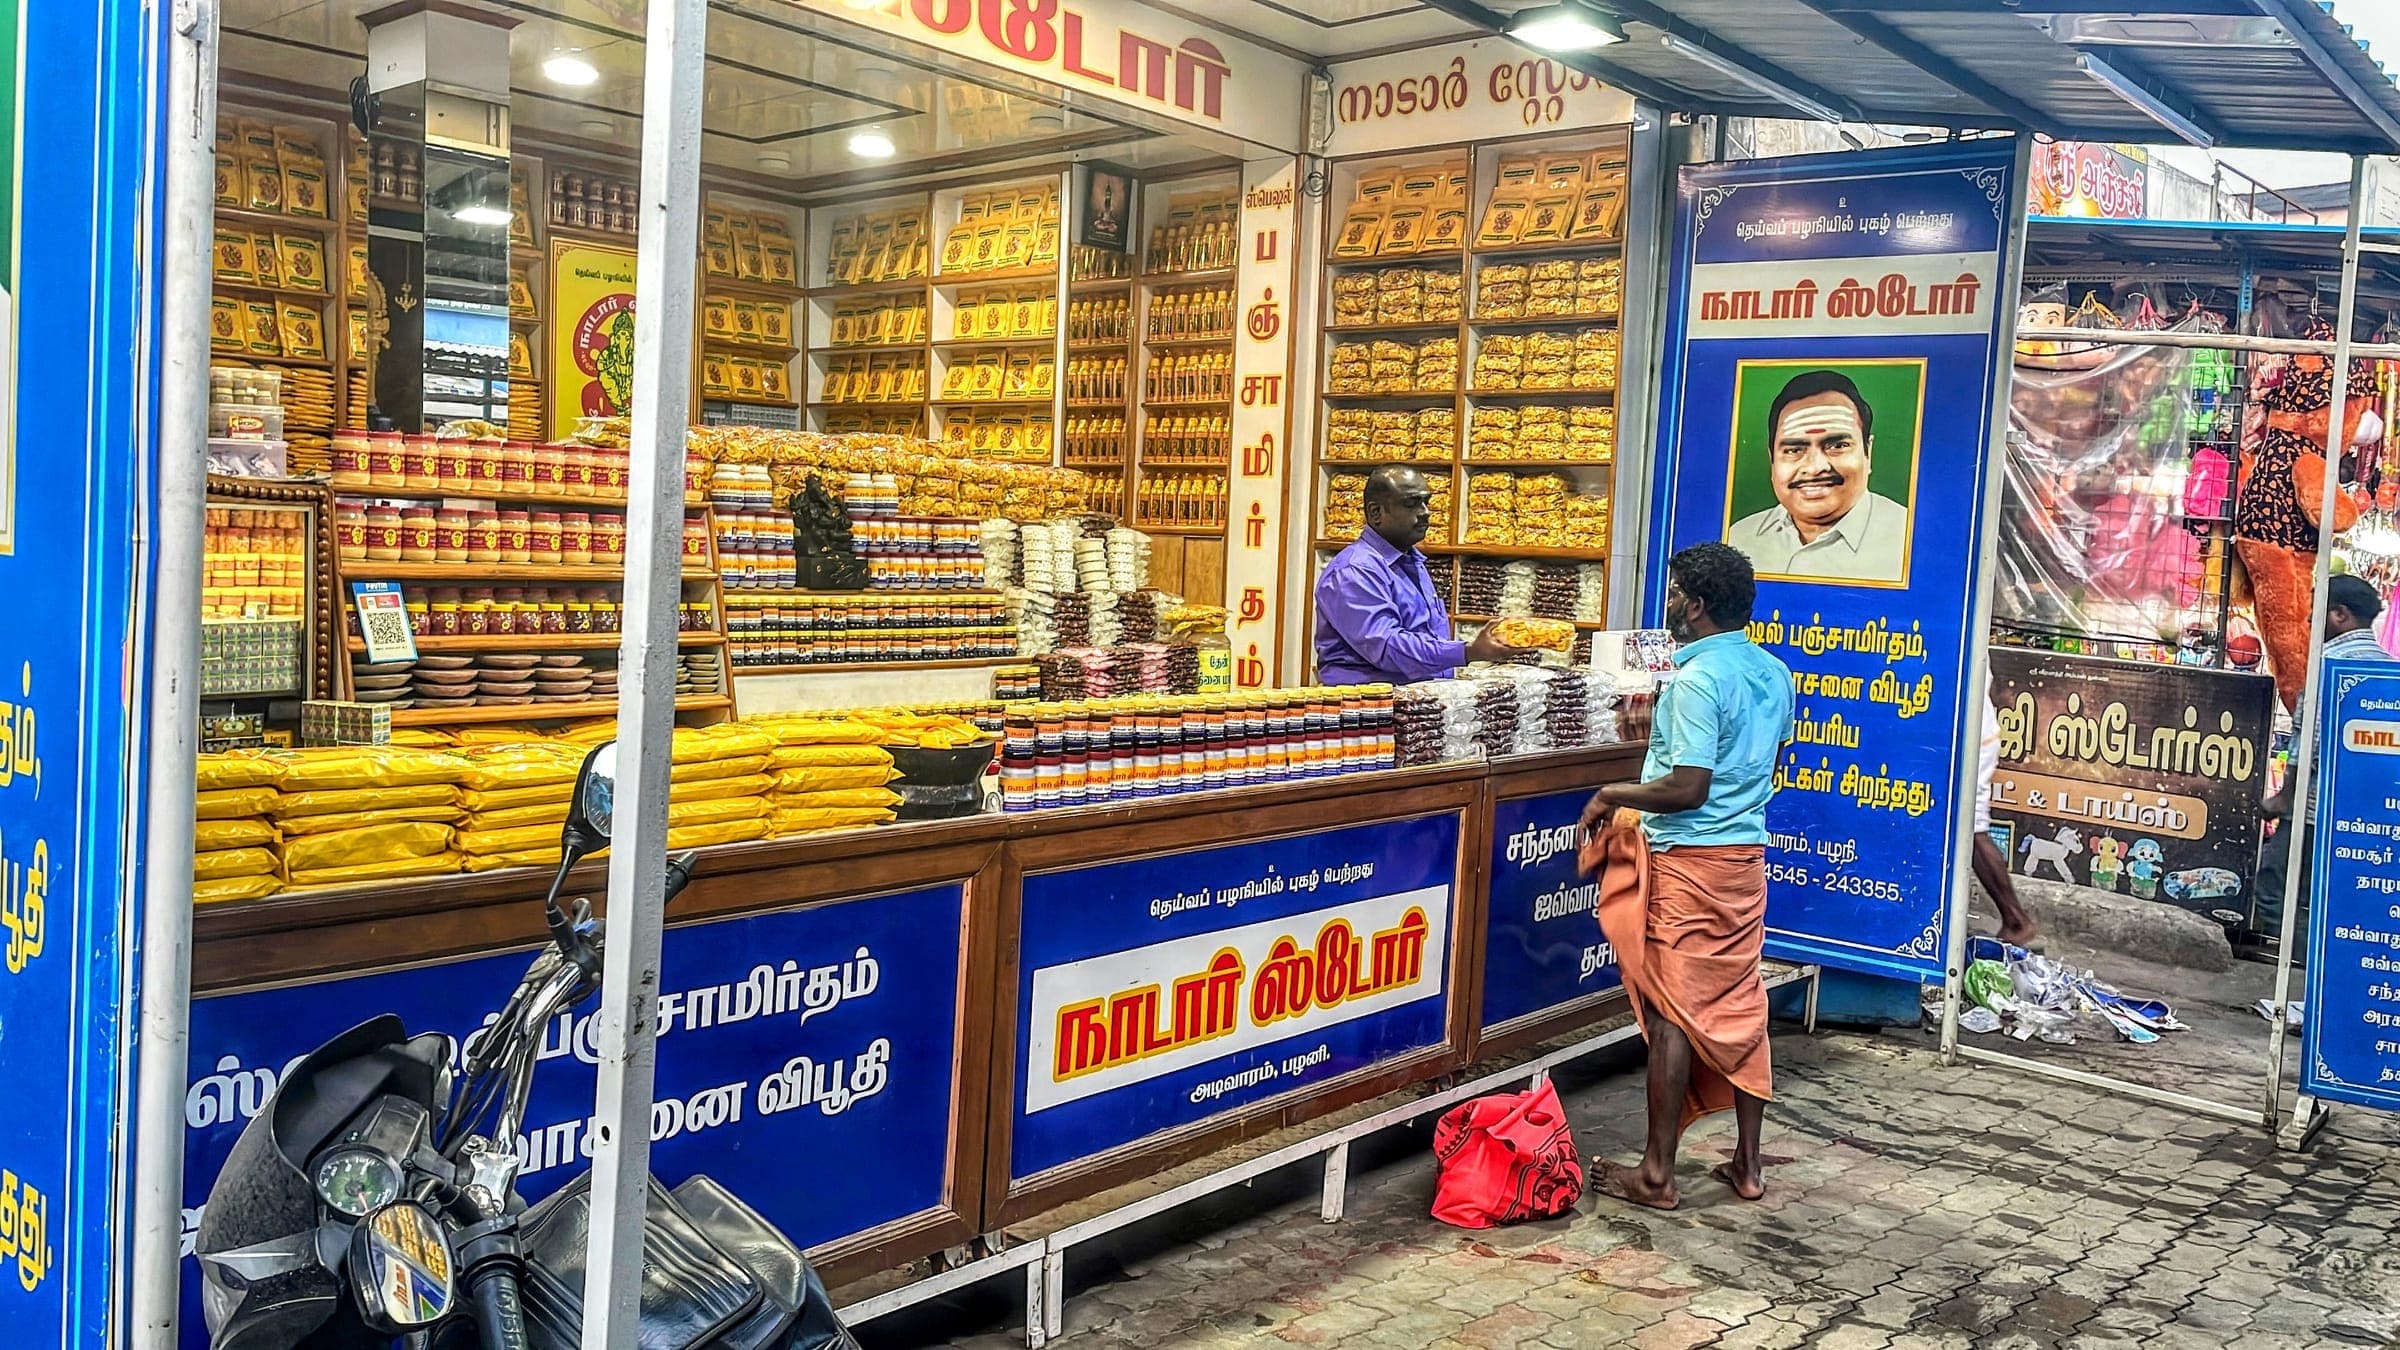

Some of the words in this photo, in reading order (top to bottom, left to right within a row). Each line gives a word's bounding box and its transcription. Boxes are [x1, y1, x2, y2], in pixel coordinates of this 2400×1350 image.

[1338, 55, 1468, 124] നാടാർ
[1488, 56, 1603, 126] സ്റ്റോ
[1736, 217, 1786, 242] தெய்வப்
[1859, 212, 1891, 235] புகழ்
[1896, 209, 1954, 231] பெற்றது
[1700, 277, 1819, 321] நாடார்
[1826, 272, 1982, 318] ஸ்டோர்
[1789, 611, 1929, 664] பஞ்சாமிர்தம்,
[1869, 669, 1934, 719] விபூதி
[2048, 692, 2255, 783] ஸ்டோர்ஸ்
[2026, 789, 2047, 809] &
[1149, 887, 1211, 920] தெய்வப்
[1288, 869, 1320, 893] புகழ்
[1323, 861, 1375, 886] பெற்றது
[1763, 864, 1808, 887] 4545
[1824, 872, 1904, 902] 243355.
[1055, 947, 1245, 1082] நாடார்
[1249, 905, 1428, 1027] ஸ்டோர்
[757, 1037, 891, 1116] விபூதி
[1190, 1060, 1279, 1103] அடிவாரம்,
